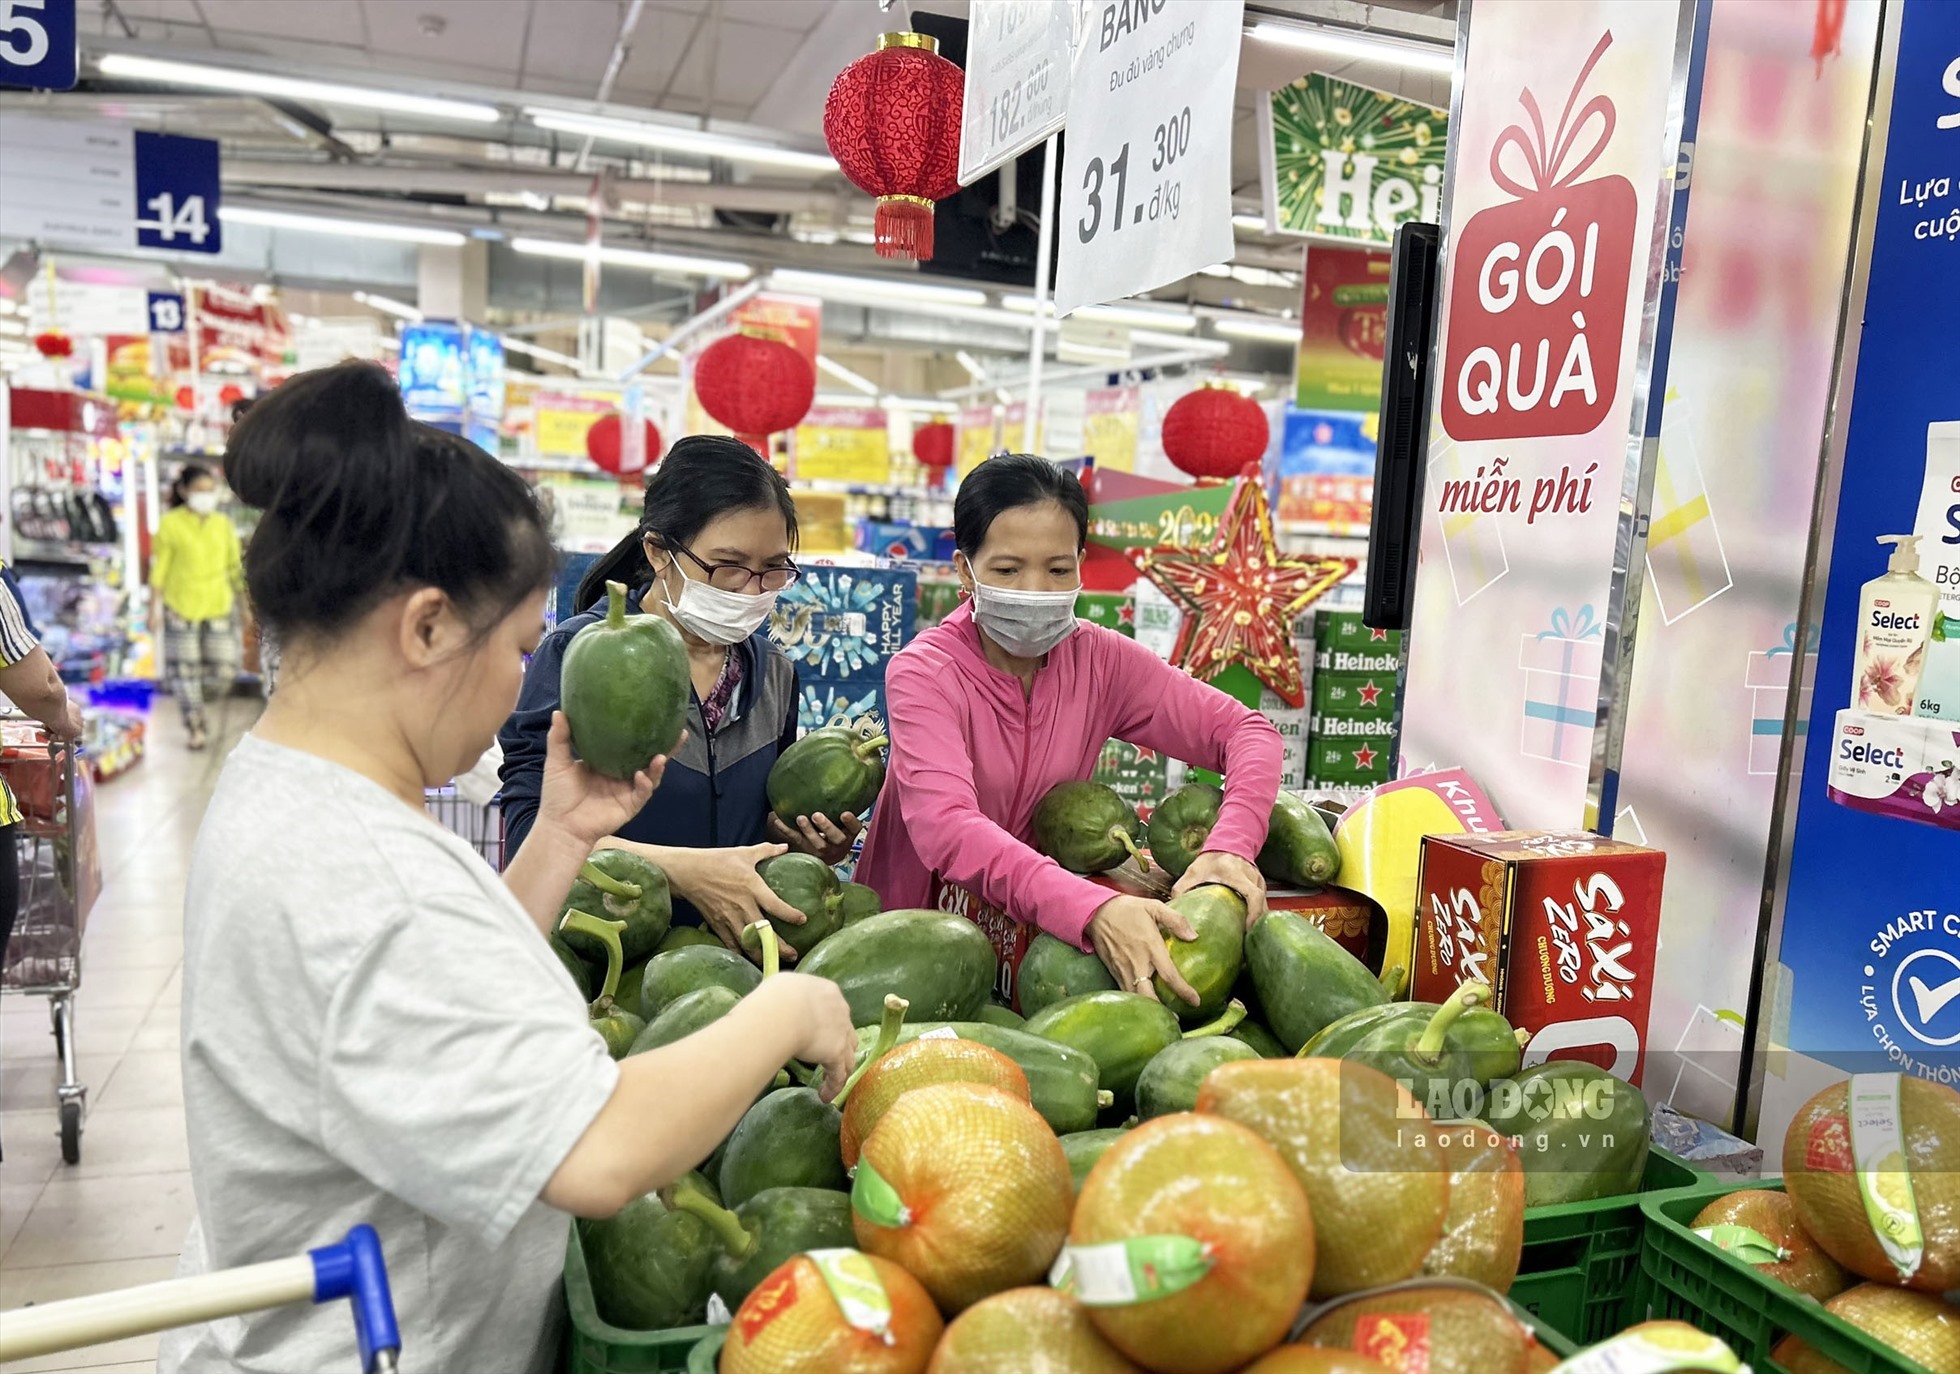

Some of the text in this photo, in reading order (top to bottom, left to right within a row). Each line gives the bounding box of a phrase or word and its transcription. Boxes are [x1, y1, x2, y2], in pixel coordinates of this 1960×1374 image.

[1109, 71, 1124, 92] Đu
[1142, 46, 1165, 75] vàng
[1152, 106, 1191, 172] 300
[147, 192, 210, 244] 14
[1148, 180, 1181, 221] đ/kg
[1899, 177, 1950, 209] Lựa
[1478, 206, 1599, 314] GÓI
[1457, 310, 1598, 416] QUÀ
[1439, 456, 1599, 524] miễn phí
[880, 600, 893, 655] HAPPY
[891, 583, 904, 627] YEAR
[1871, 610, 1920, 630] Select
[1840, 739, 1904, 769] Select
[1843, 726, 1864, 735] COOP
[1430, 892, 1454, 967] ZERO
[1541, 896, 1583, 985] ZERO
[1870, 910, 1938, 958] SMART
[1859, 985, 1879, 1022] LỰA
[1872, 1023, 1914, 1070] CHỌN
